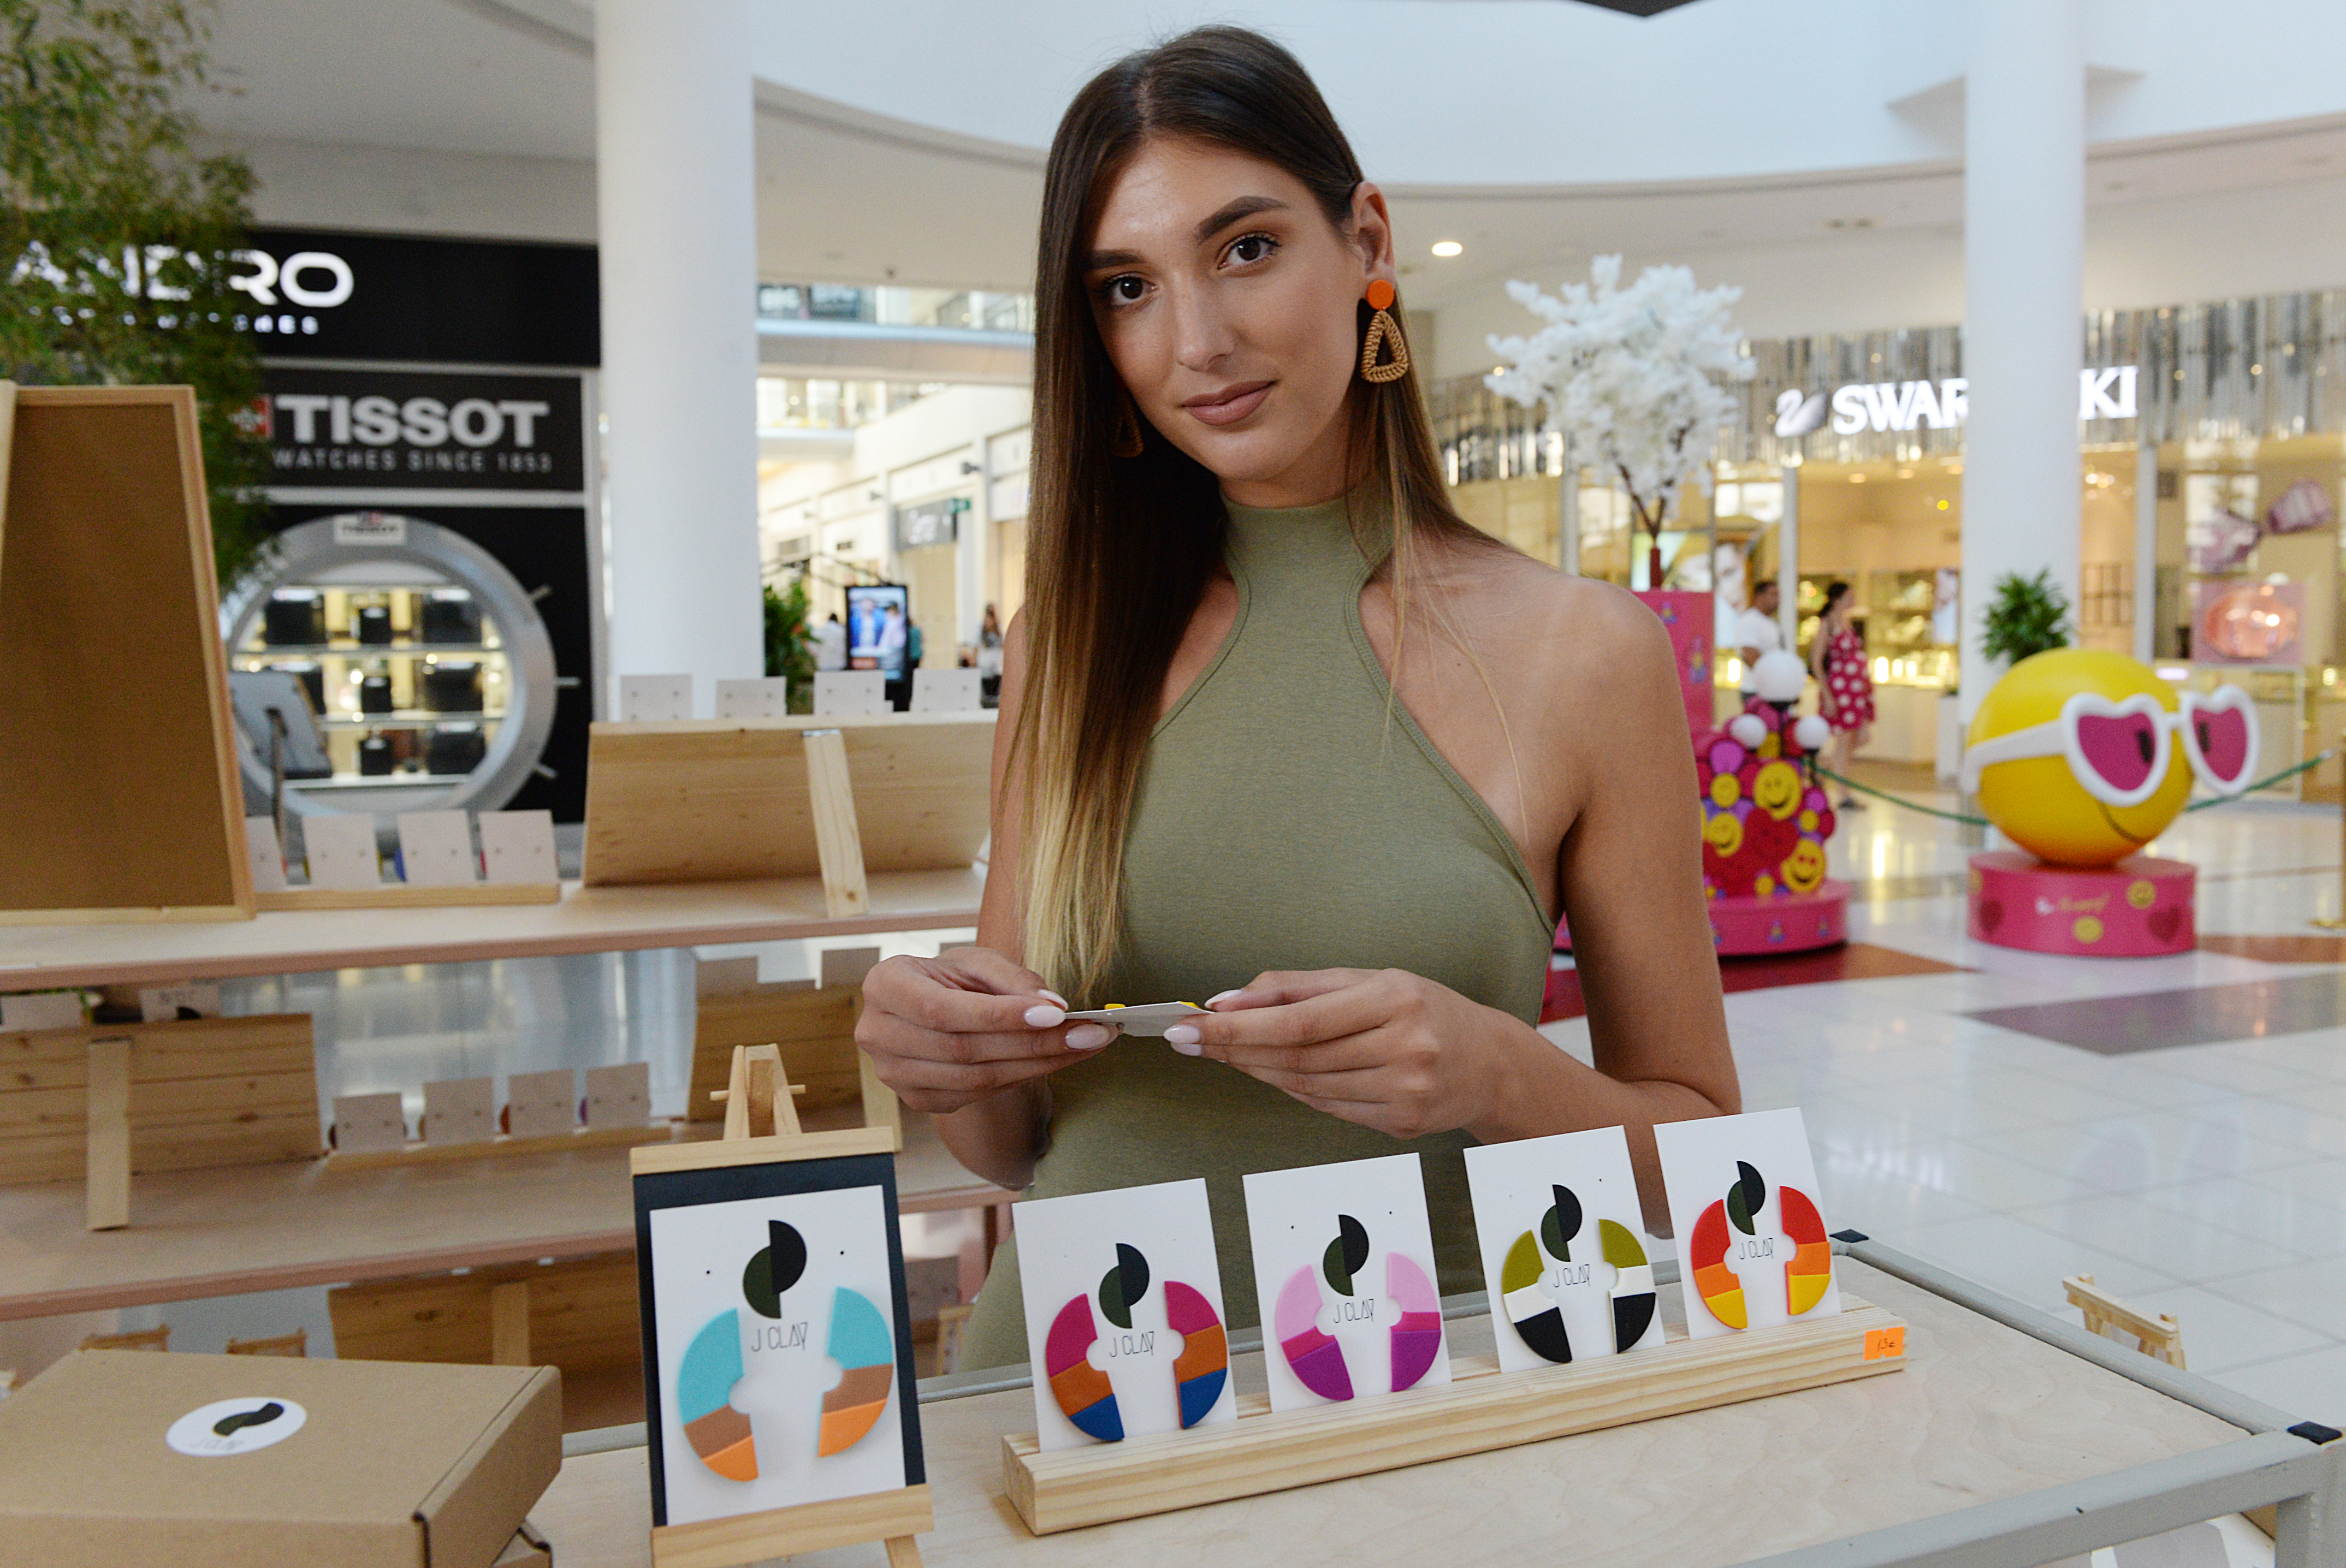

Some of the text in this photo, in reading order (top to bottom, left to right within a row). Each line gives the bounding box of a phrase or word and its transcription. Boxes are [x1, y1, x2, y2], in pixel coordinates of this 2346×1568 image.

[1832, 365, 2138, 435] SWARKI
[274, 394, 550, 449] TISSOT
[273, 448, 396, 471] WATCHES
[407, 450, 485, 472] SINCE
[1739, 1238, 1774, 1260] J CLAY
[1553, 1264, 1590, 1288] J CLAY
[1333, 1298, 1374, 1323] J CLAY
[751, 1322, 808, 1352] J CLAY
[1109, 1331, 1154, 1358] J CLAY
